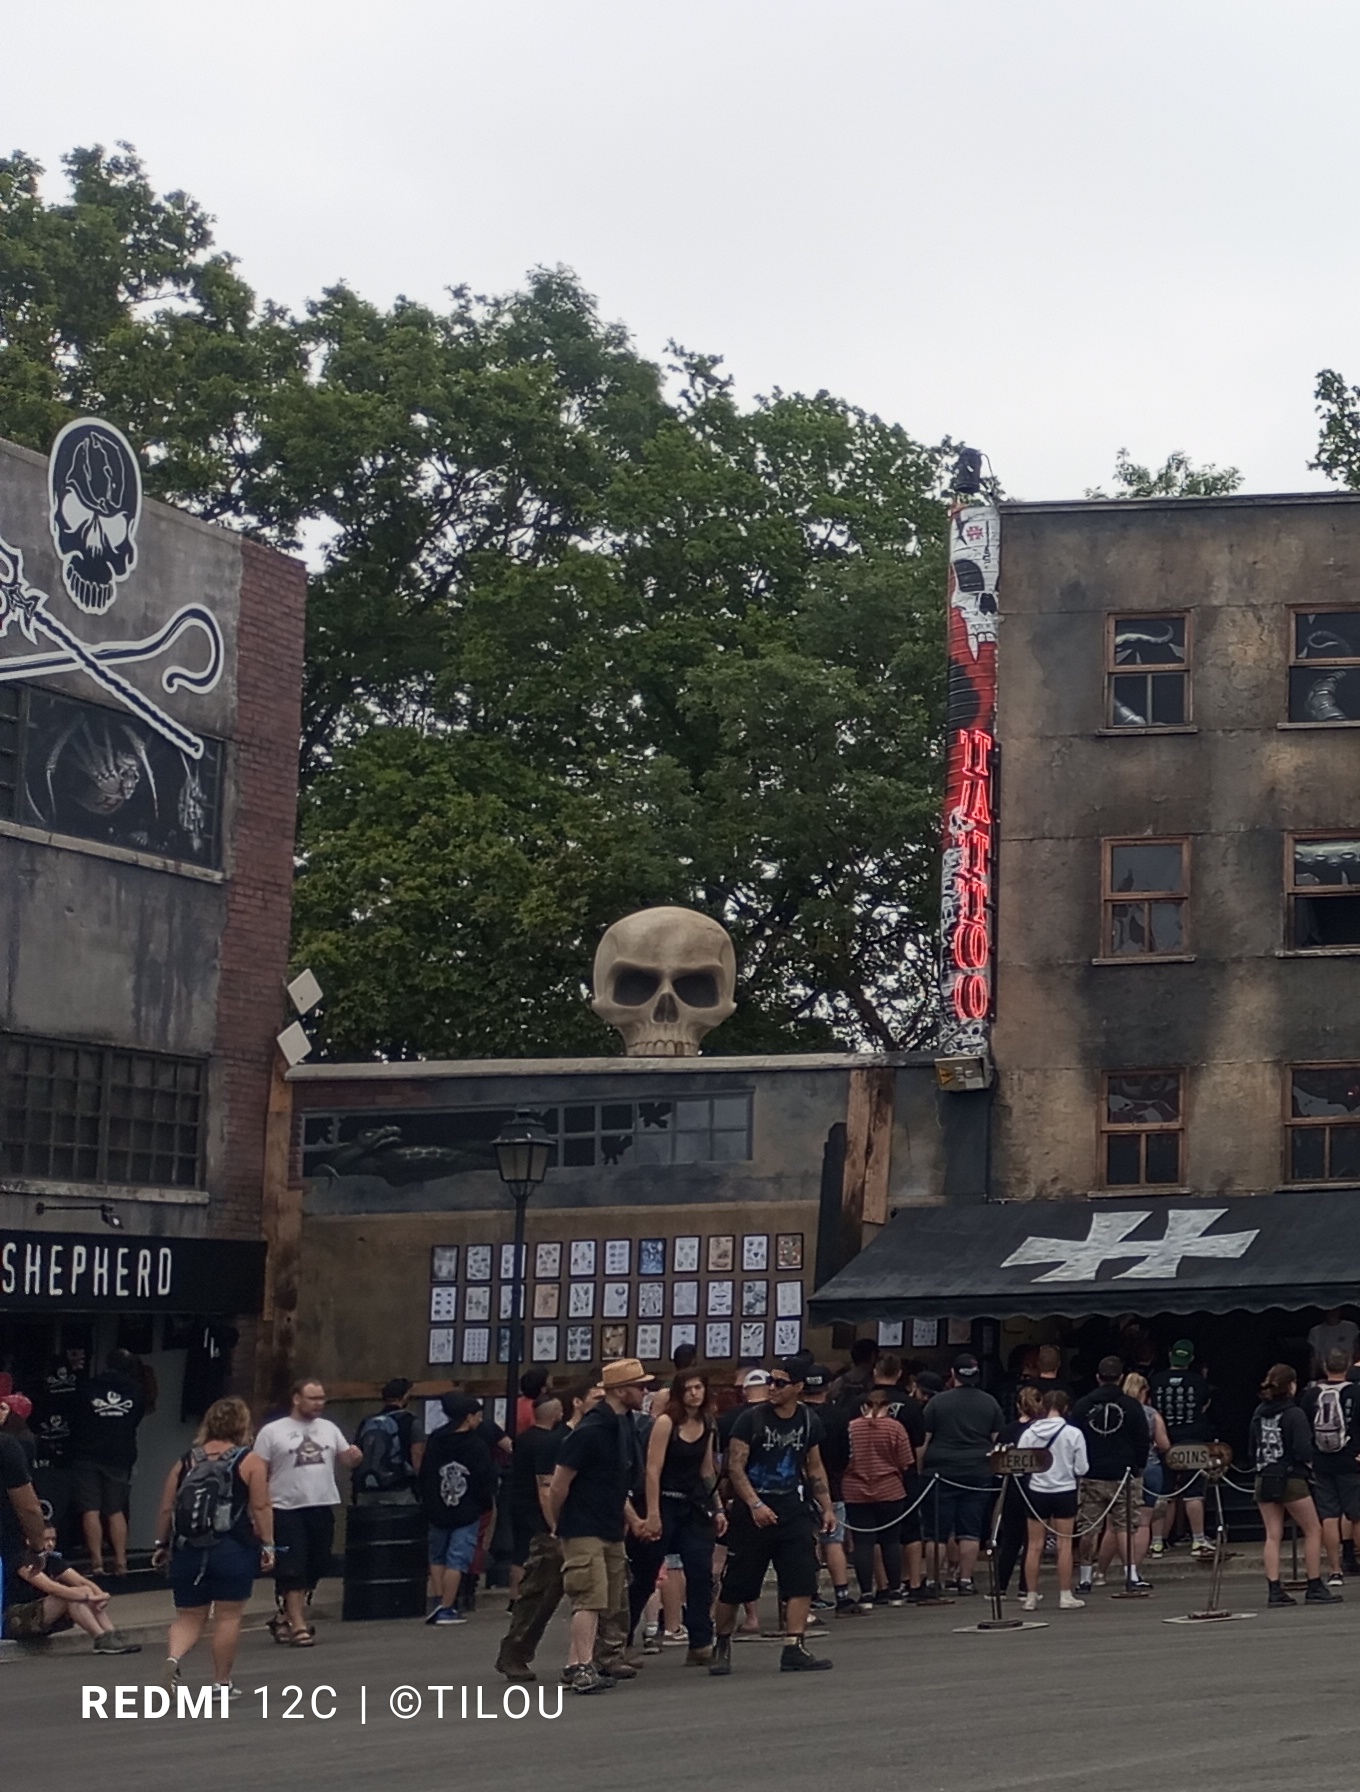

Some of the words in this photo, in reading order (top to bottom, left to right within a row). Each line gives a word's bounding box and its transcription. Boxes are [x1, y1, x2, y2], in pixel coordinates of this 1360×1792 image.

[963, 728, 992, 1019] TATTOO
[2, 1242, 172, 1298] SHEPHERD
[1170, 1450, 1208, 1465] SOINS
